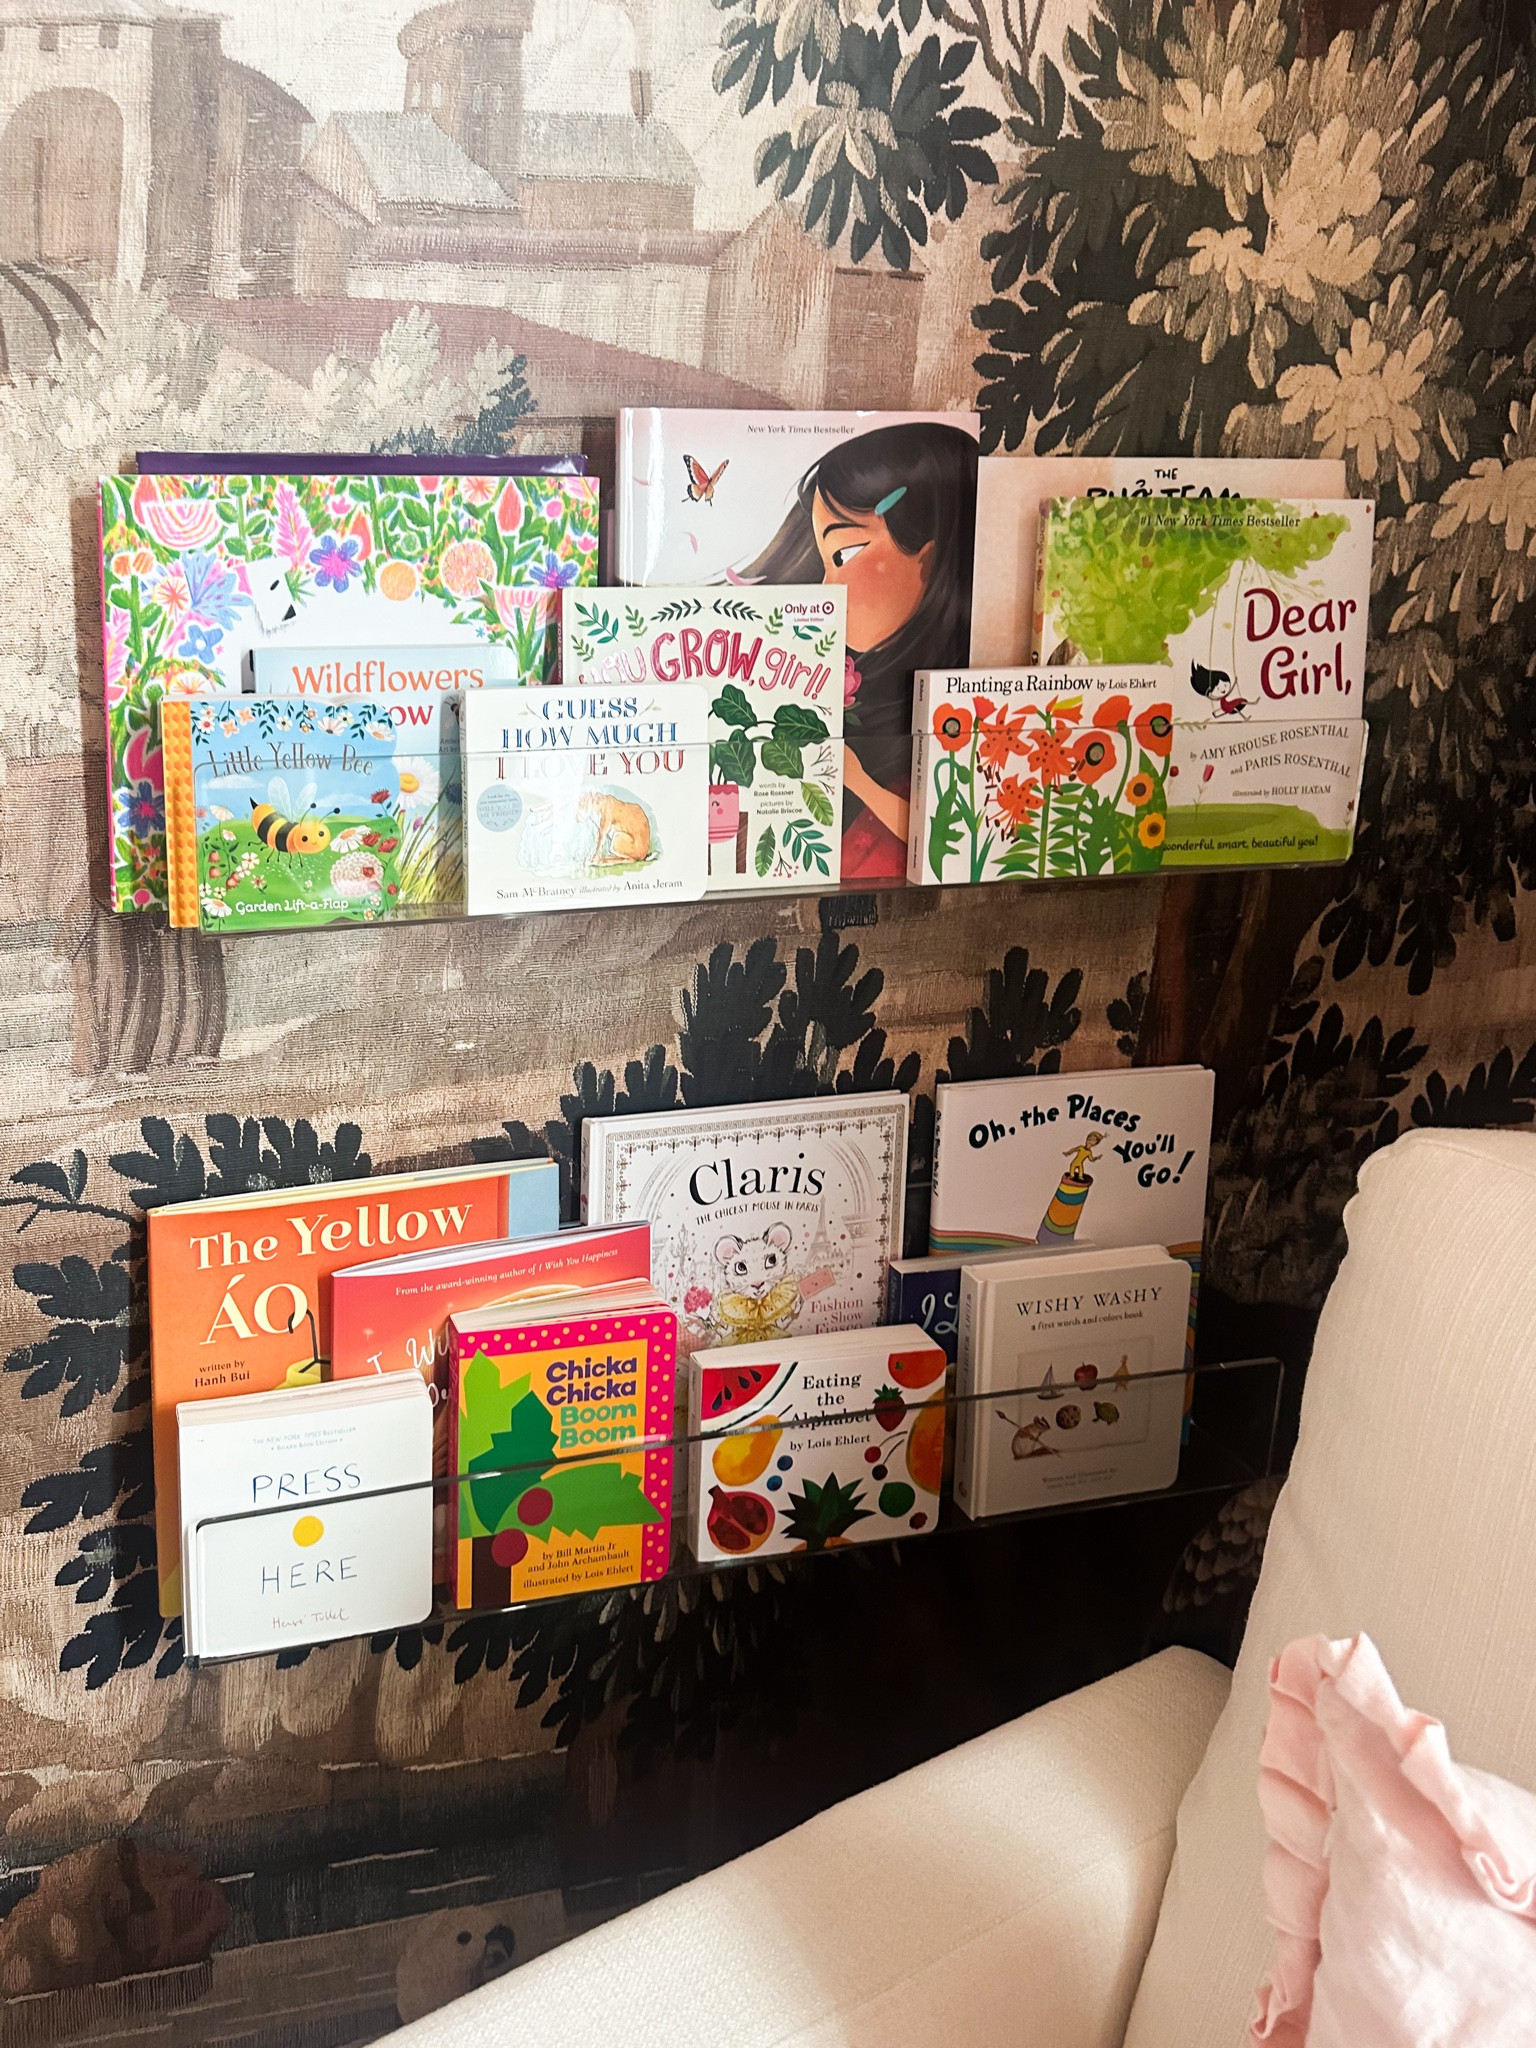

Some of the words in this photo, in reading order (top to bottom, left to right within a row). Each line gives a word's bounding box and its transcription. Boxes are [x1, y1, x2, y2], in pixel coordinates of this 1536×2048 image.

[747, 425, 764, 433] New
[767, 425, 786, 433] York
[788, 425, 811, 434] Times
[814, 425, 855, 434] Bestseller
[1154, 468, 1178, 480] THE
[1140, 516, 1151, 526] #1
[1155, 516, 1180, 526] New
[1183, 515, 1207, 527] York
[1211, 515, 1244, 527] Times
[1246, 516, 1300, 527] Bestseller
[785, 603, 807, 615] Only
[810, 603, 820, 613] at
[1244, 588, 1356, 642] Dear
[291, 660, 484, 694] Wildflowers
[759, 648, 832, 700] girl!
[1260, 642, 1352, 700] Girl,
[945, 676, 1012, 696] Planting
[1014, 681, 1023, 692] a
[1026, 674, 1094, 692] Rainbow
[1096, 679, 1107, 692] by
[1108, 679, 1128, 689] Lois
[1129, 678, 1157, 689] Ehlert
[542, 696, 639, 720] GUESS
[500, 724, 573, 751] HOW
[586, 721, 679, 748] MUCH
[1190, 752, 1197, 762] by
[1200, 746, 1226, 760] AMY
[1229, 733, 1277, 754] KROUSE
[1280, 724, 1350, 743] ROSENTHAL
[207, 745, 263, 778] Little
[267, 741, 333, 770] Yellow
[342, 743, 373, 776] Bee
[495, 756, 505, 780] I
[521, 752, 608, 778] LOVE
[618, 750, 686, 775] YOU
[1231, 766, 1243, 775] and
[1244, 754, 1281, 772] PARIS
[1284, 752, 1351, 778] ROSENTHAL
[1271, 786, 1299, 795] HOLLY
[1301, 784, 1331, 794] HATAM
[1251, 836, 1296, 848] beautiful
[1298, 834, 1318, 850] you!
[496, 889, 518, 899] Sam
[522, 886, 576, 898] McBratney
[579, 884, 613, 894] illustrated
[613, 885, 621, 894] by
[623, 880, 650, 891] Anita
[652, 879, 683, 889] Jeram
[235, 901, 283, 916] Garden
[284, 899, 349, 915] Lift-a-Flap
[968, 1119, 1016, 1149] Oh,
[1020, 1105, 1060, 1128] the
[1066, 1093, 1141, 1133] Places
[1112, 1133, 1175, 1164] You'll
[689, 1152, 826, 1206] Claris
[1137, 1150, 1196, 1188] Go!
[696, 1213, 711, 1226] THE
[715, 1204, 749, 1219] CHICEST
[752, 1200, 781, 1212] MOUSE
[784, 1201, 794, 1210] IN
[796, 1201, 820, 1213] PARIS
[189, 1231, 279, 1270] The
[286, 1203, 474, 1257] Yellow
[395, 1286, 418, 1296] From
[420, 1282, 434, 1293] the
[435, 1273, 498, 1291] award-winning
[499, 1267, 526, 1279] author
[528, 1263, 537, 1275] of
[538, 1263, 543, 1273] I
[545, 1260, 564, 1270] Wish
[565, 1257, 580, 1266] You
[581, 1248, 619, 1265] Happiness
[199, 1274, 309, 1346] ÁO
[811, 1298, 863, 1313] Fashion
[1016, 1295, 1084, 1317] WISHY
[1093, 1286, 1163, 1307] WASHY
[831, 1311, 862, 1323] Show
[1037, 1320, 1055, 1331] first
[1057, 1316, 1081, 1327] words
[1082, 1315, 1098, 1325] and
[1099, 1312, 1123, 1322] colors
[1124, 1310, 1143, 1320] book
[199, 1360, 231, 1373] written
[231, 1359, 245, 1371] by
[546, 1356, 637, 1383] Chicka
[194, 1372, 227, 1388] Hanh
[230, 1369, 250, 1383] Bui
[802, 1373, 862, 1390] Eating
[546, 1379, 637, 1406] Chicka
[817, 1392, 845, 1407] the
[560, 1403, 637, 1427] Boom
[790, 1408, 872, 1431] Alphabet
[560, 1425, 637, 1449] Boom
[790, 1441, 803, 1452] by
[807, 1438, 832, 1449] Lois
[835, 1434, 870, 1446] Ehlert
[252, 1463, 361, 1504] PRESS
[528, 1563, 545, 1573] and
[547, 1559, 570, 1570] John
[572, 1549, 629, 1566] Archambault
[542, 1552, 554, 1561] by
[556, 1548, 572, 1558] Bill
[574, 1544, 605, 1555] Martin
[607, 1542, 616, 1550] Jr
[261, 1555, 358, 1595] HERE
[523, 1573, 569, 1588] illustrated
[571, 1573, 582, 1582] by
[585, 1568, 604, 1579] Lois
[606, 1565, 634, 1576] Ehlert
